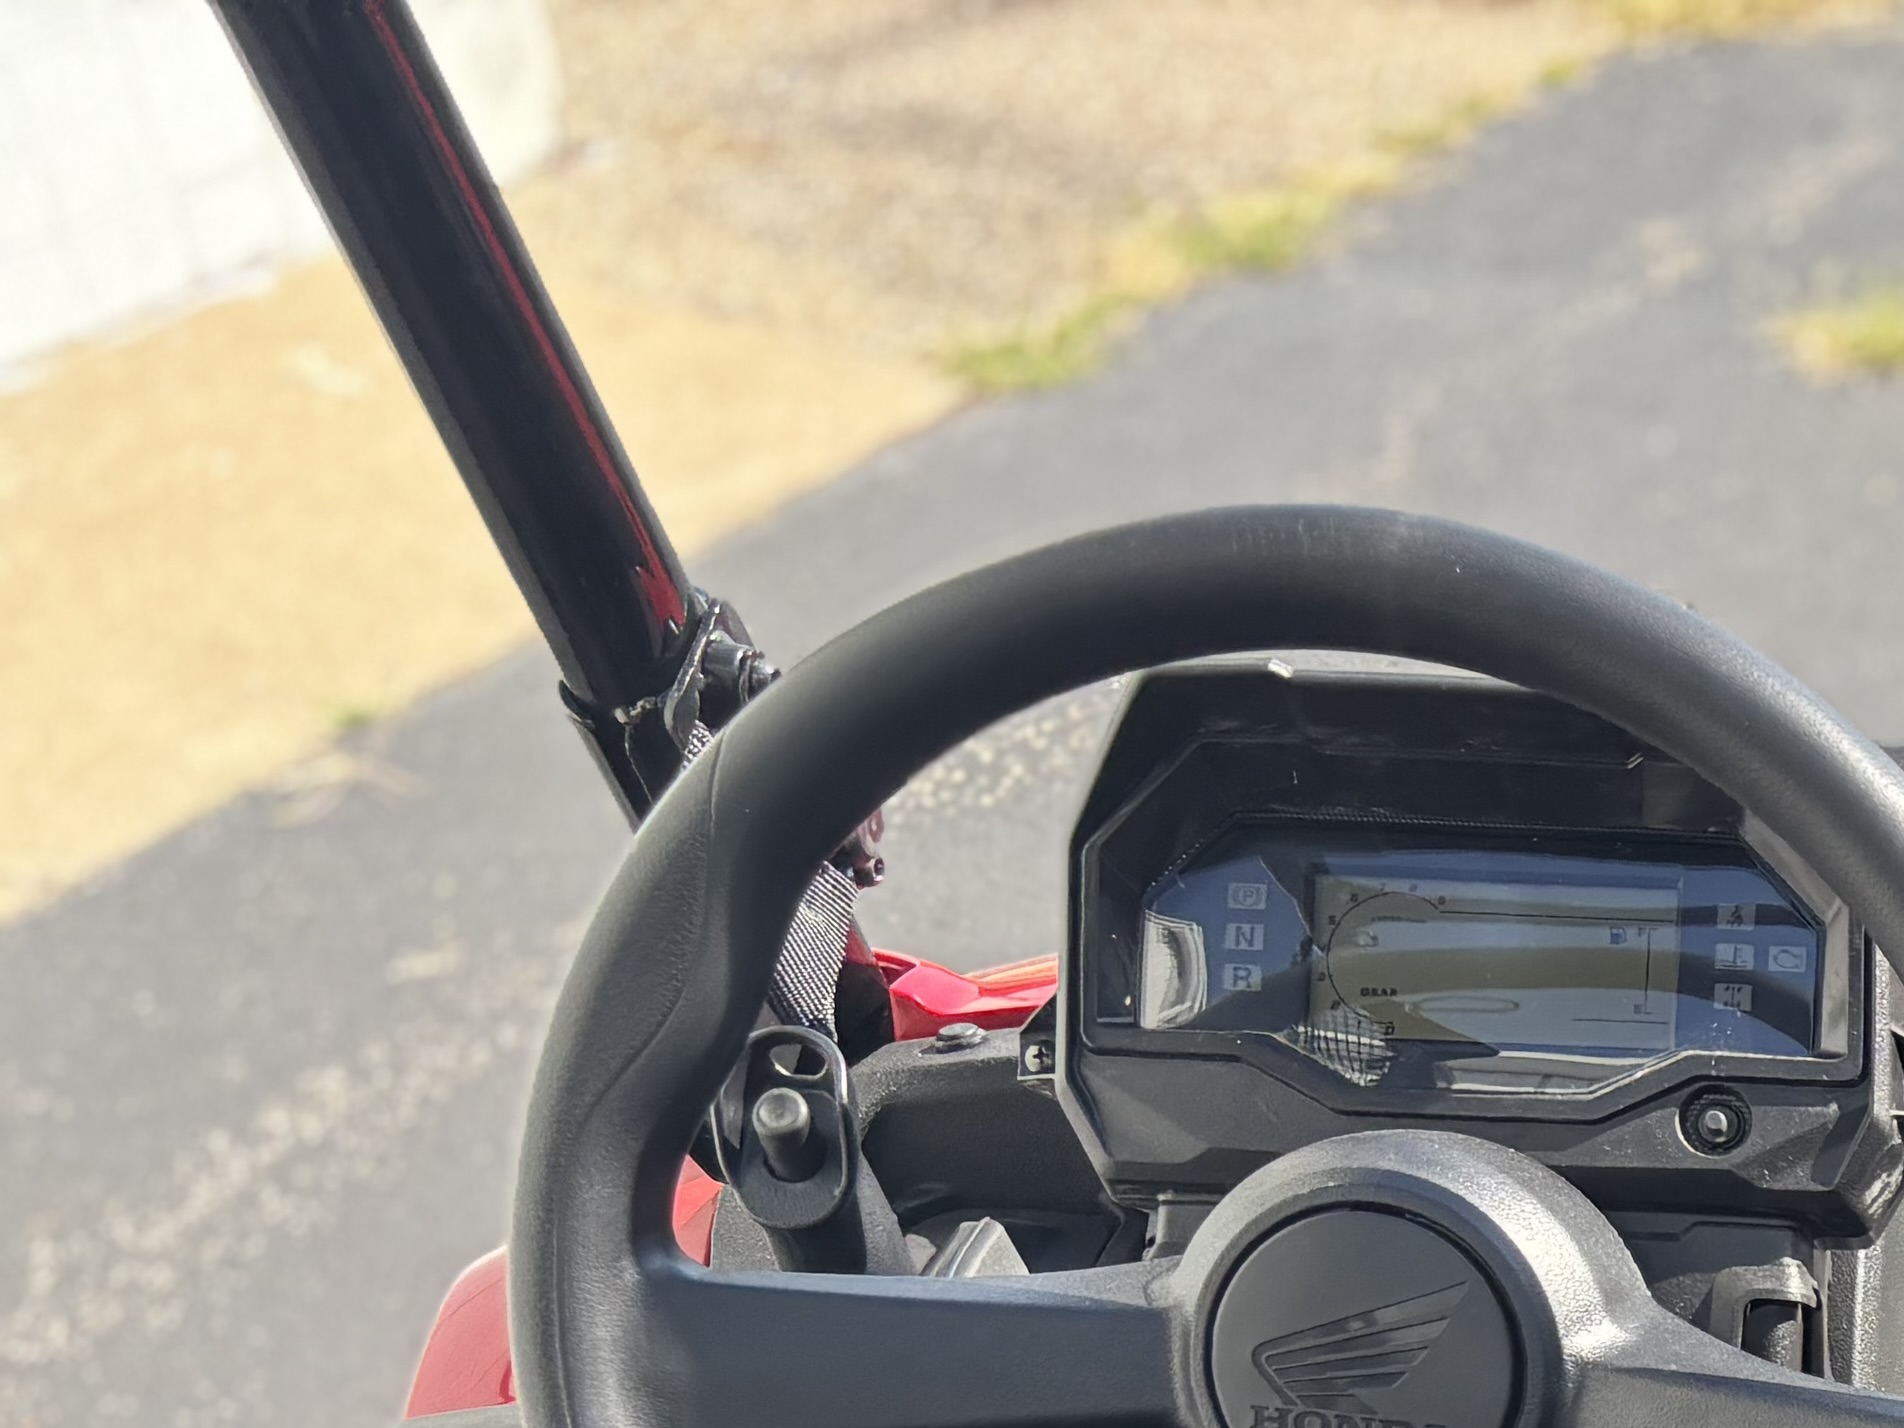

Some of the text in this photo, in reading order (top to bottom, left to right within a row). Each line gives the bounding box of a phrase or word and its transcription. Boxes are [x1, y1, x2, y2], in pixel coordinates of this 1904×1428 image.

[1234, 924, 1256, 949] N
[1232, 965, 1253, 990] R
[1360, 986, 1398, 998] GEAR
